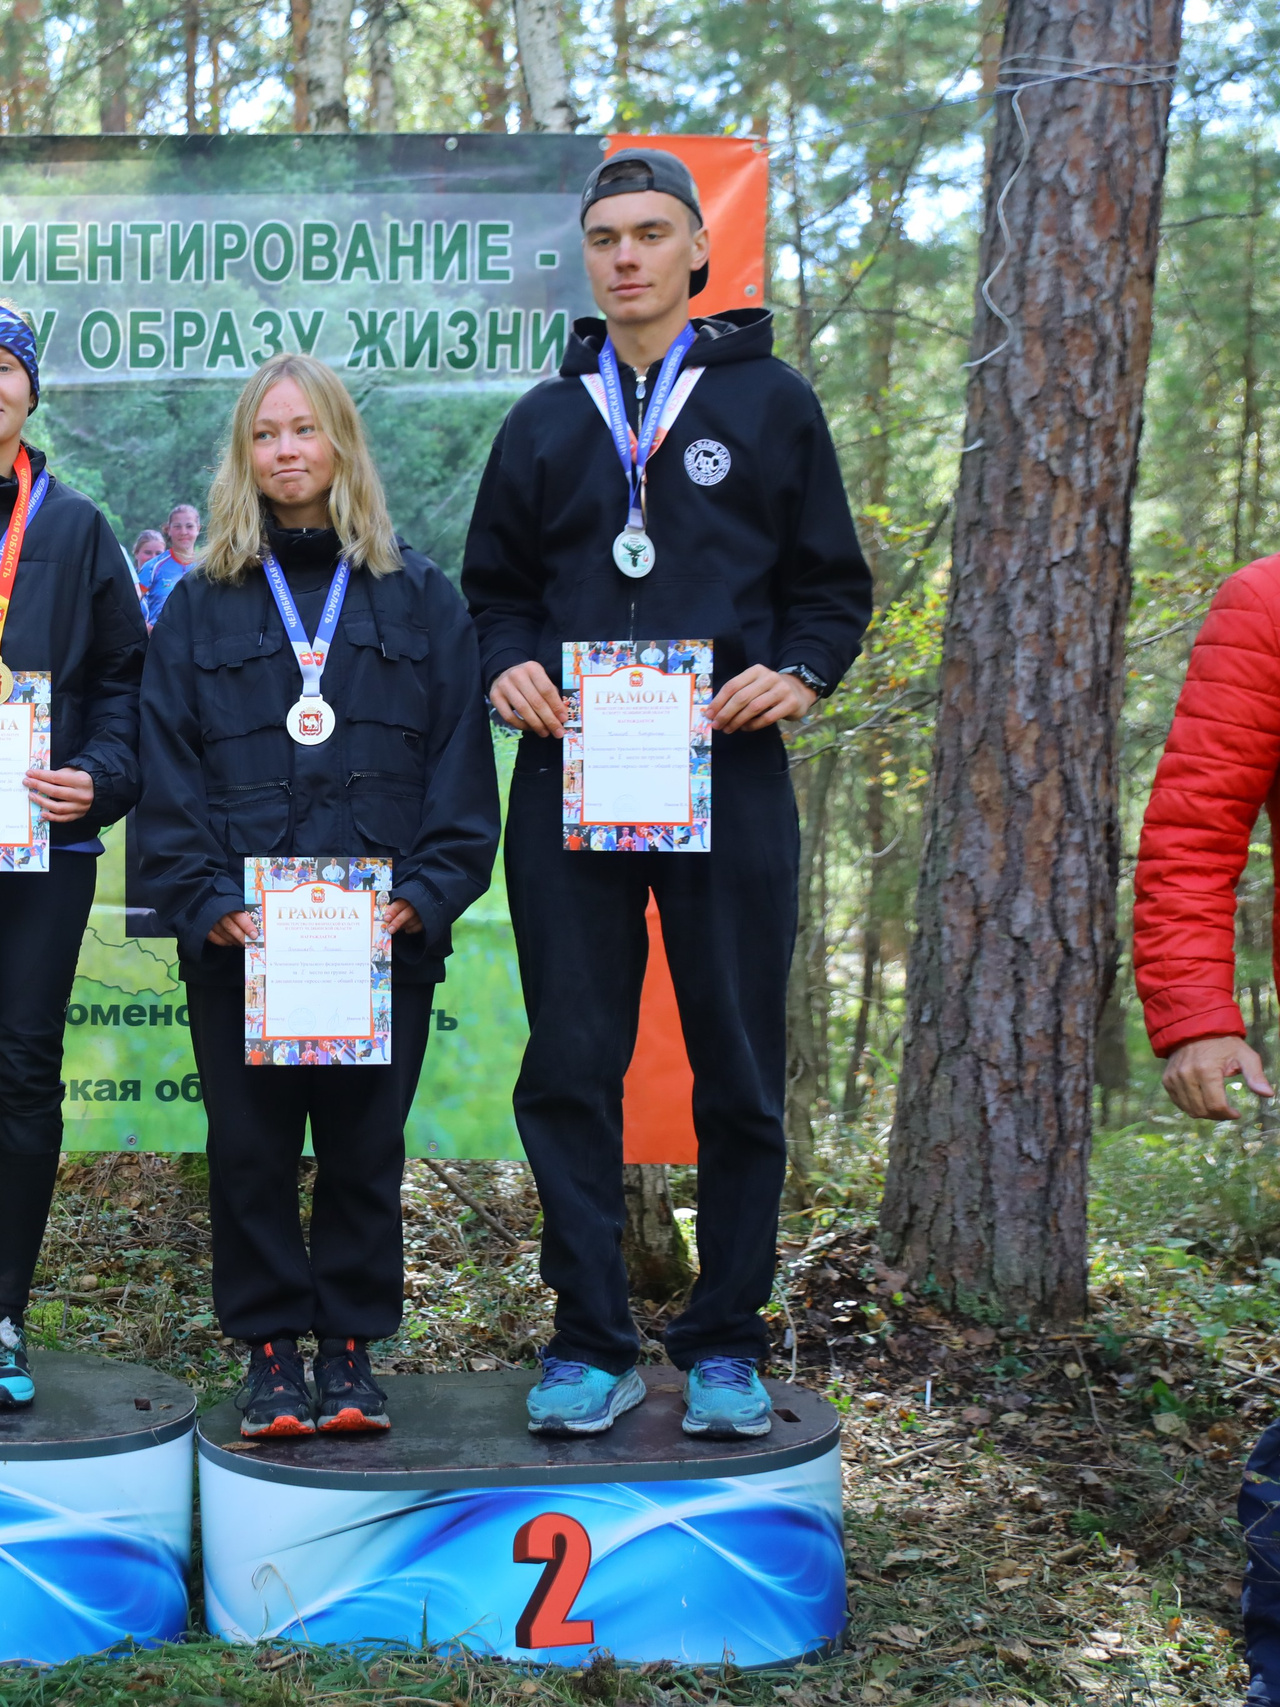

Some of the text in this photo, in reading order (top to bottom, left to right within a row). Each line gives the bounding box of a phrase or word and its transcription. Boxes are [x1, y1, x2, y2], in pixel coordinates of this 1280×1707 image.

[79, 307, 325, 371] ОБРАЗУ
[345, 307, 570, 372] ЖИЗНИ
[2, 468, 28, 578] ЧЕЛЯБИНСКАЯ ОБЛАСТЬ
[270, 565, 297, 628] ЧЕЛЯБИНСКАЯ
[324, 584, 343, 625] ОБЛАСТЬ
[594, 690, 678, 705] ГРАМОТА
[277, 907, 360, 920] ГРАМОТА
[512, 1510, 595, 1649] 2
